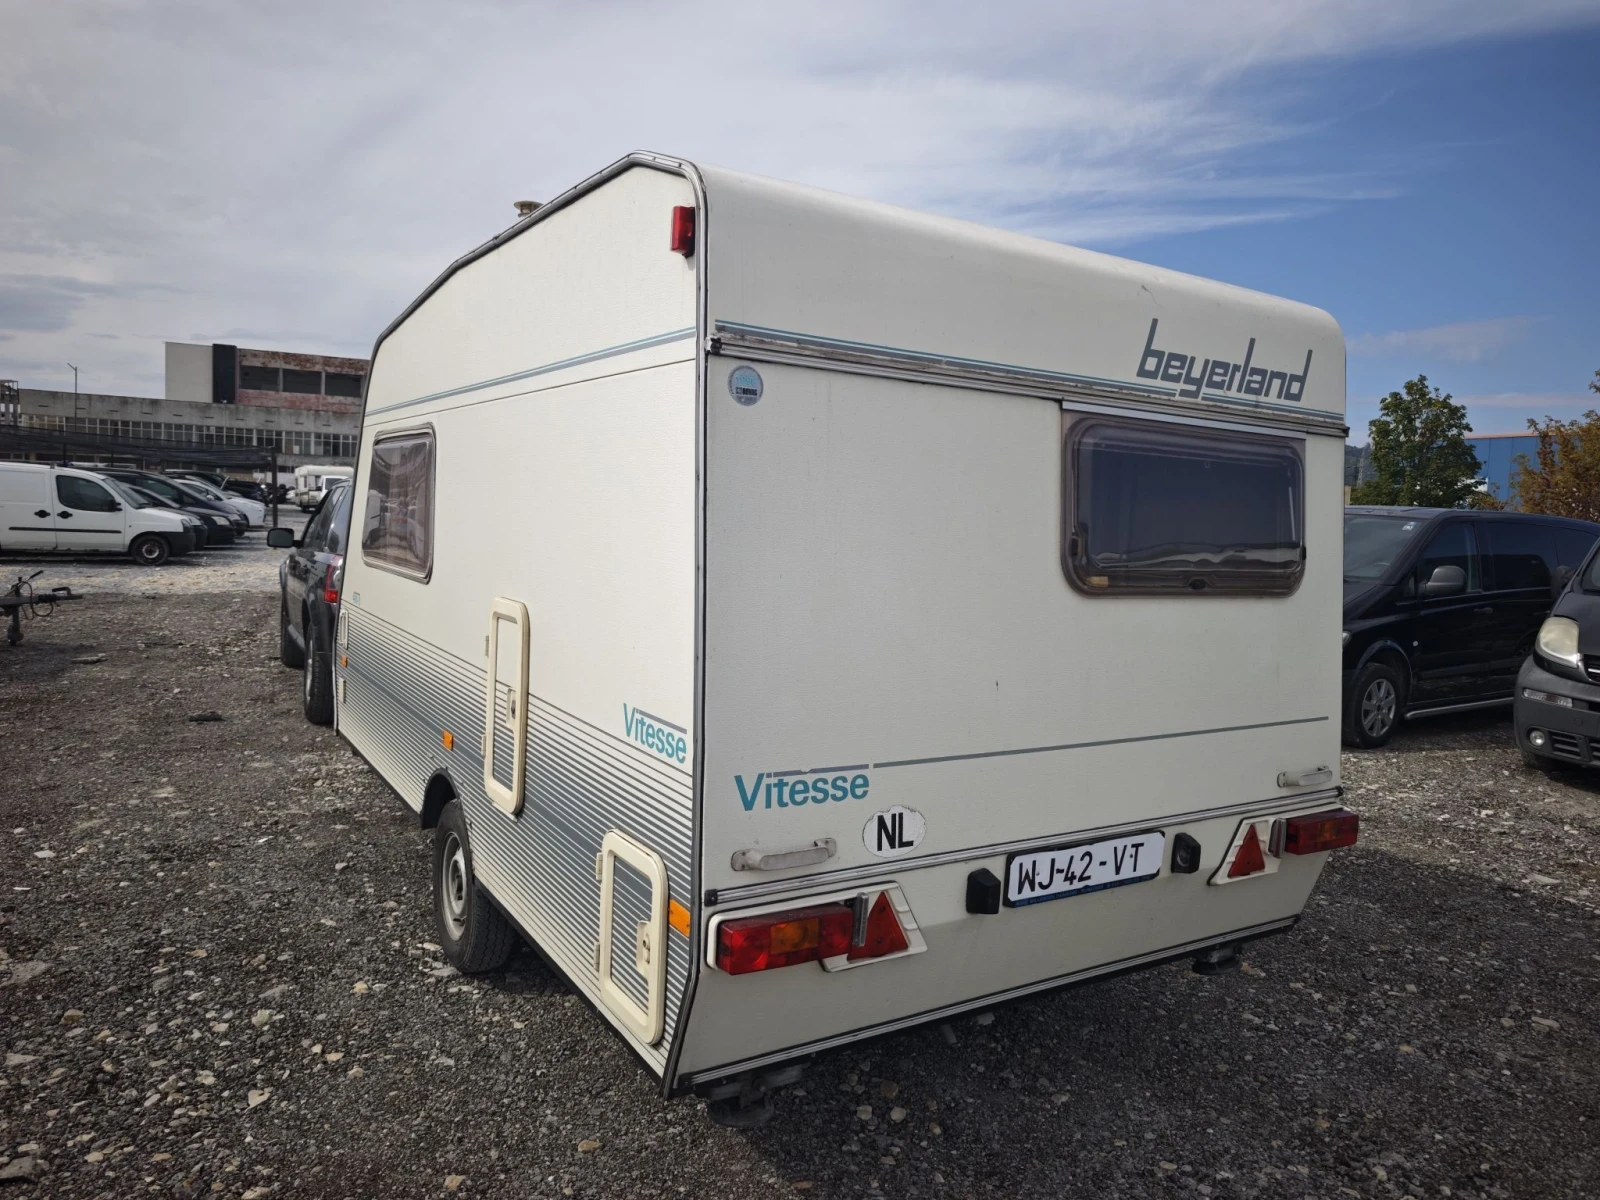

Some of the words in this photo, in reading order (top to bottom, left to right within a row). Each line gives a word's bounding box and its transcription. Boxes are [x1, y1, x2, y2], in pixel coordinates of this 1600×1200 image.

[1136, 318, 1313, 402] beyerland
[623, 703, 687, 764] Vitesse
[734, 772, 869, 811] Vitesse
[877, 812, 914, 851] NL
[1017, 843, 1145, 895] WJ-42-VT
